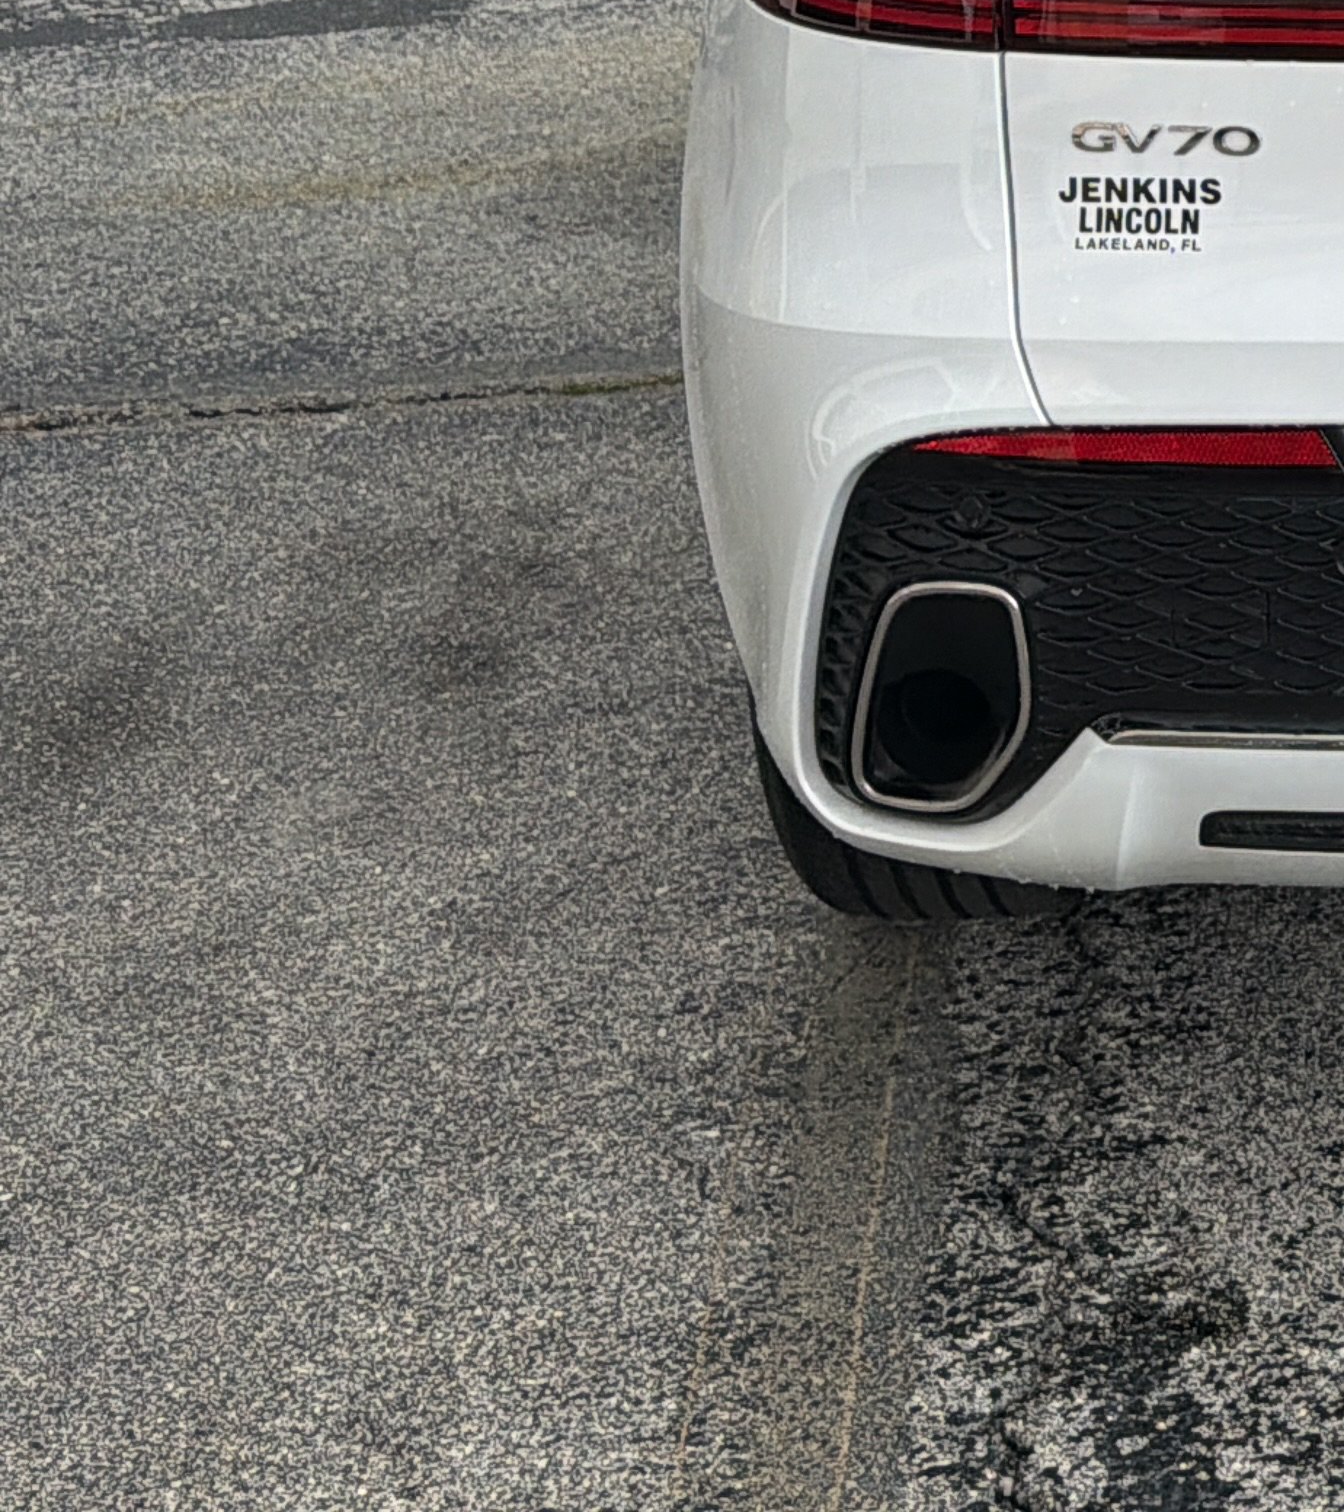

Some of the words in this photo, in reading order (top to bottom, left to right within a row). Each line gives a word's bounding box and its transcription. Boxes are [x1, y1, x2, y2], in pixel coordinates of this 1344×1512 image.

[1070, 121, 1263, 157] GV70
[1058, 175, 1223, 205] JENKINS
[1078, 206, 1200, 235] LINCOLN
[1074, 237, 1176, 255] LAKELAND,
[1181, 238, 1202, 252] FL
